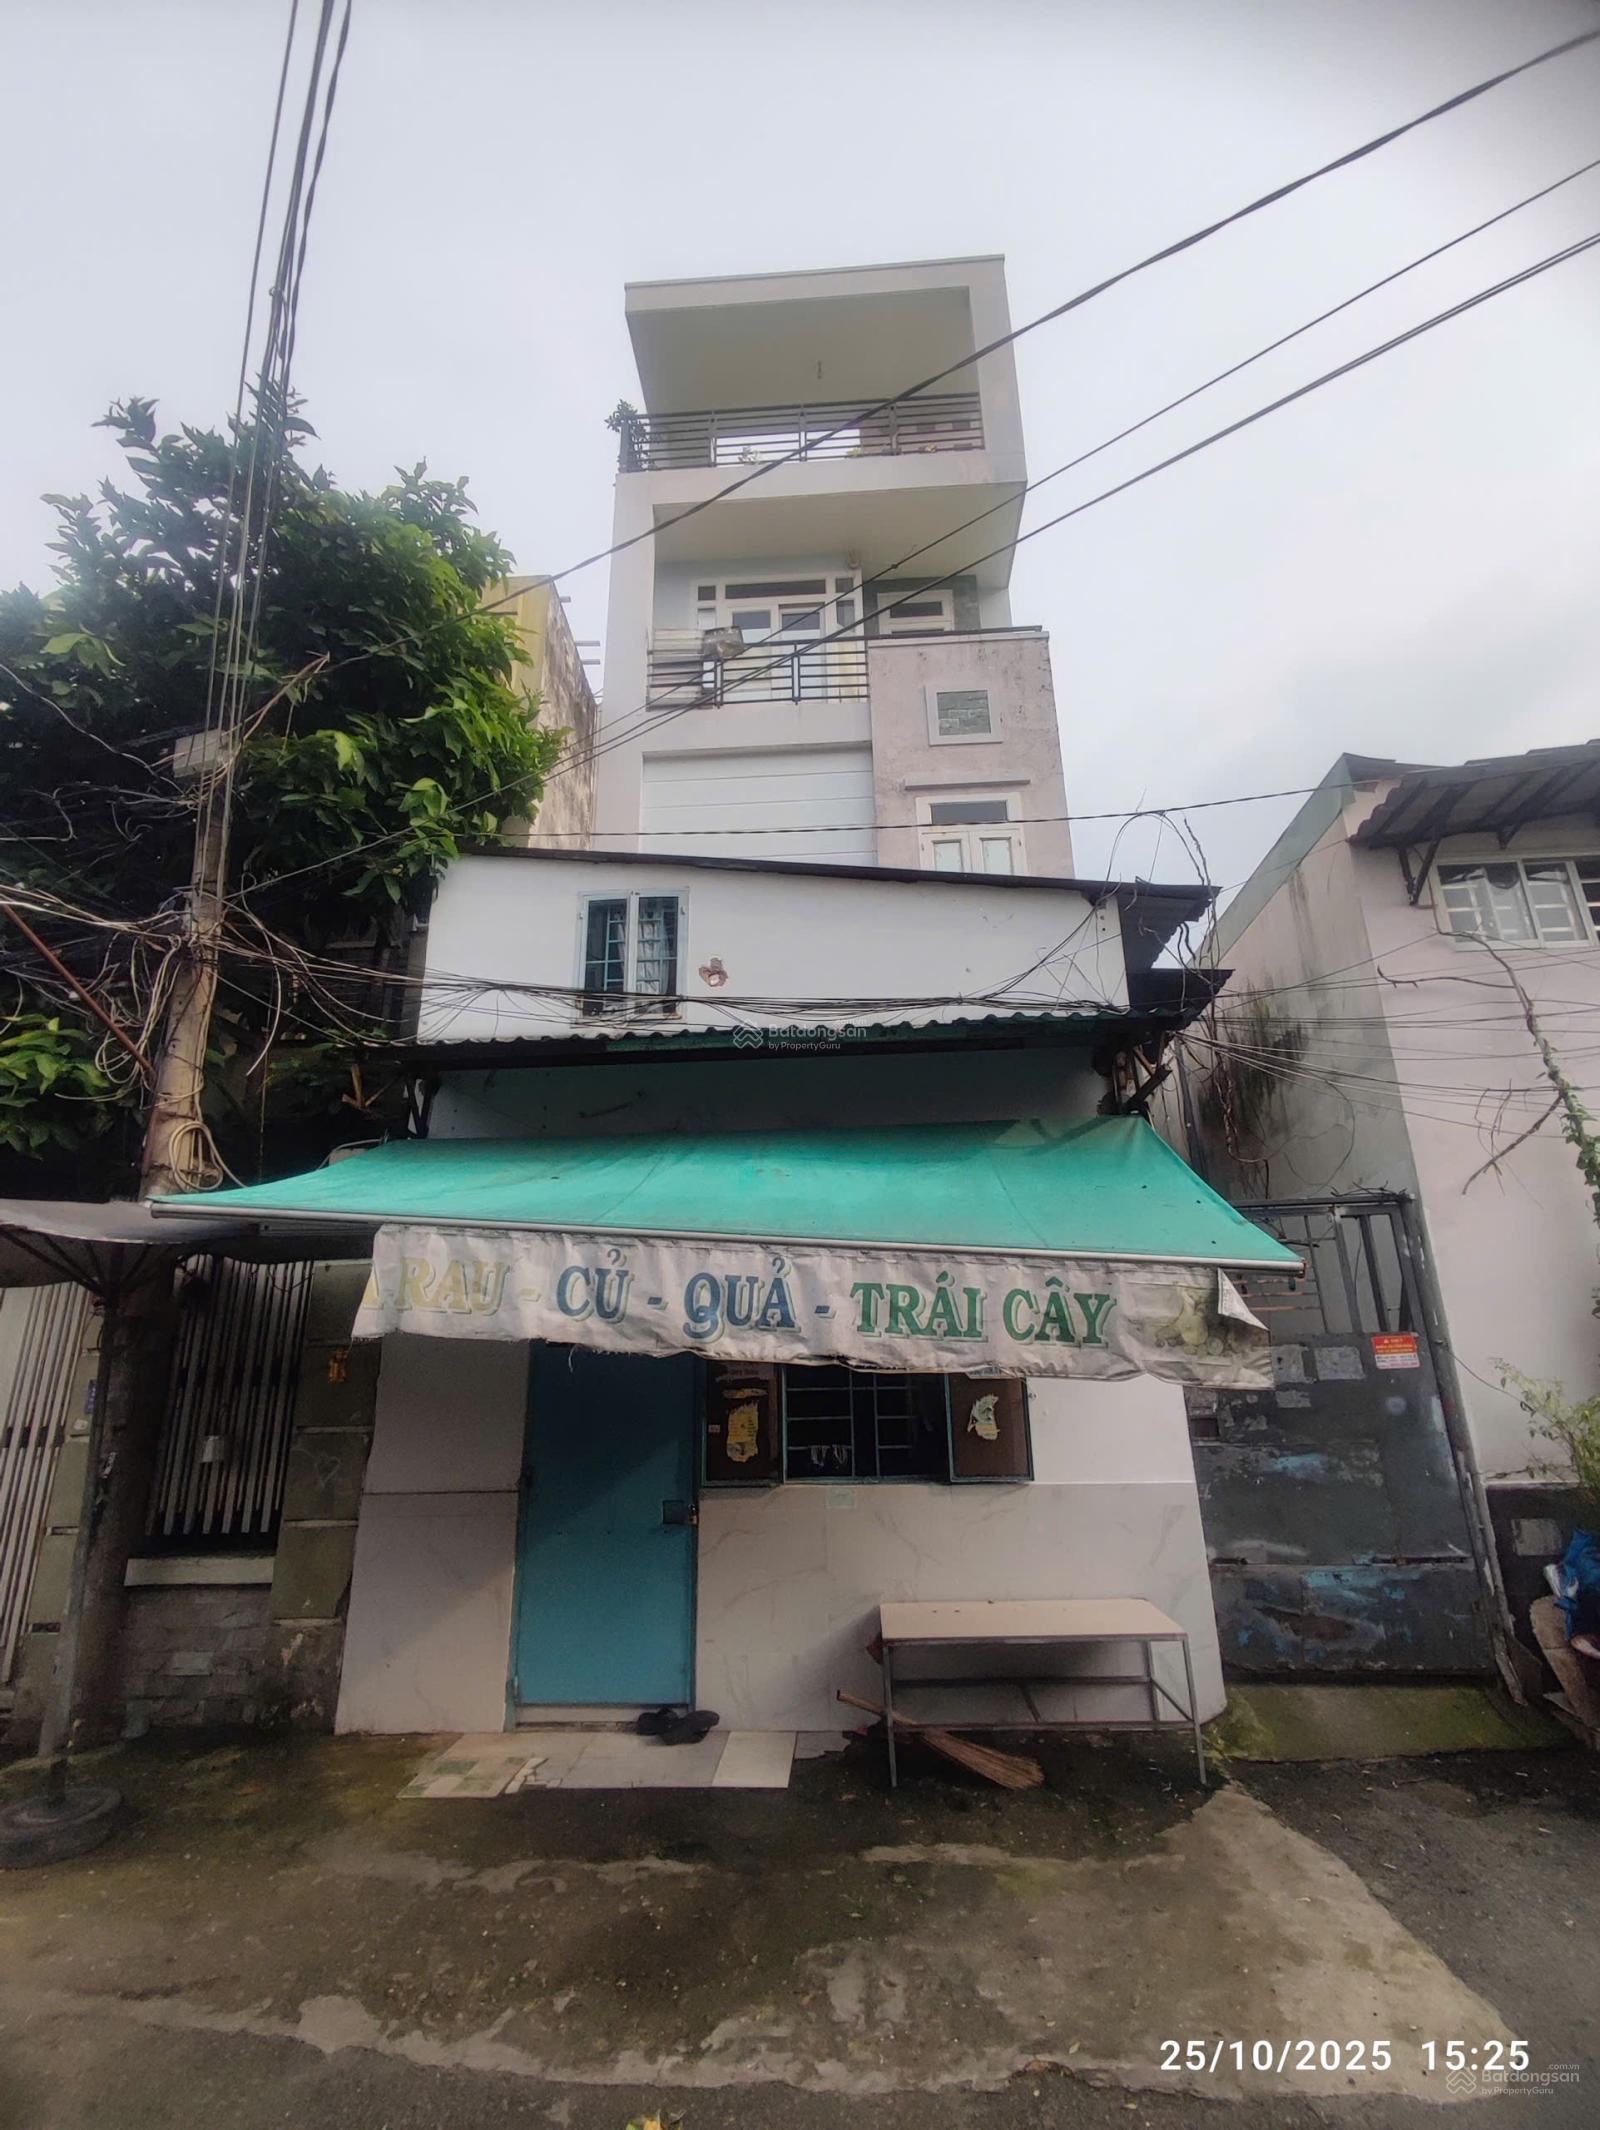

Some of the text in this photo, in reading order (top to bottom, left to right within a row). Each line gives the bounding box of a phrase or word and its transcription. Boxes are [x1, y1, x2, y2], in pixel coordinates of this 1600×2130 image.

[395, 1257, 511, 1316] RAU
[556, 1248, 635, 1324] CỦ
[683, 1257, 802, 1343] QUẢ
[850, 1270, 989, 1343] TRÁI
[1002, 1275, 1116, 1348] CÂY
